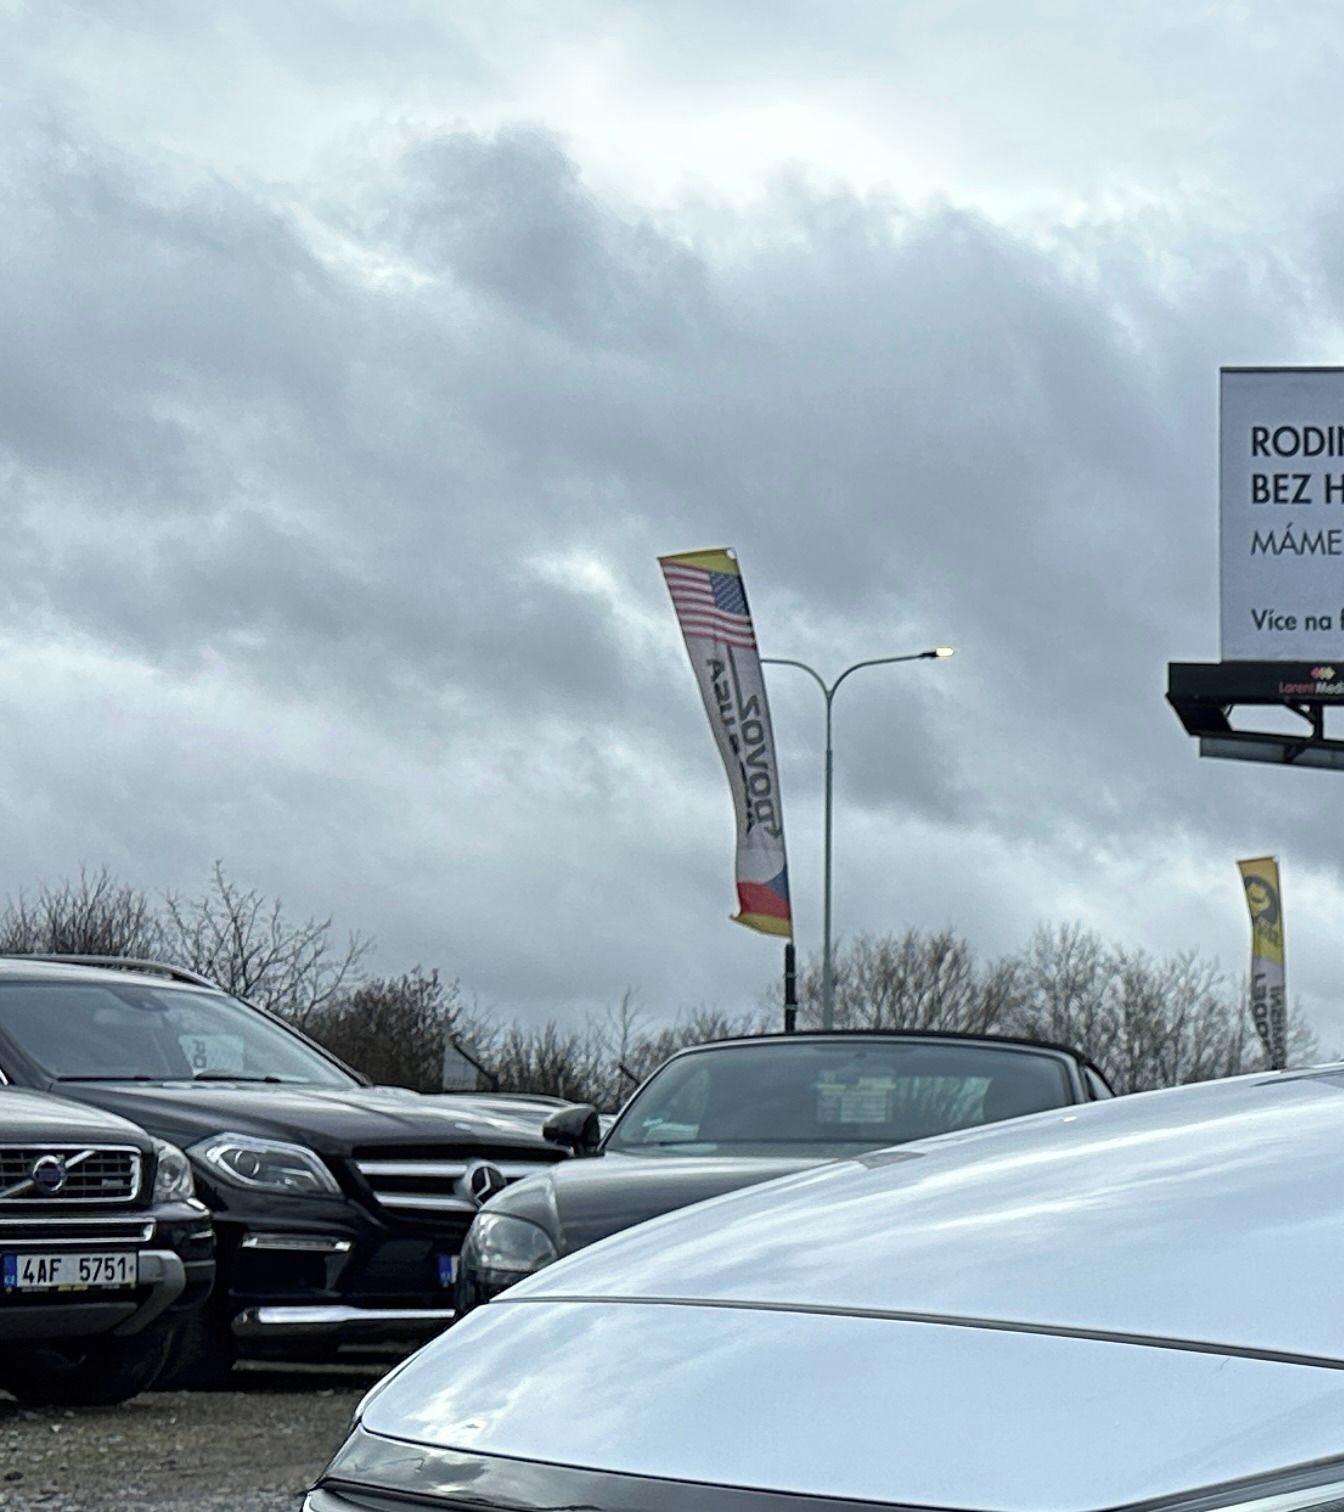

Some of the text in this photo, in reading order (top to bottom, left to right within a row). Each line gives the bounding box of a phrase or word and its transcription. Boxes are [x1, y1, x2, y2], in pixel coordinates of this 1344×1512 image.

[1252, 473, 1312, 505] BEZ
[1250, 522, 1343, 556] MÁME
[1251, 607, 1297, 631] Více
[1304, 616, 1332, 631] na
[23, 1257, 126, 1283] 4AF 5751
